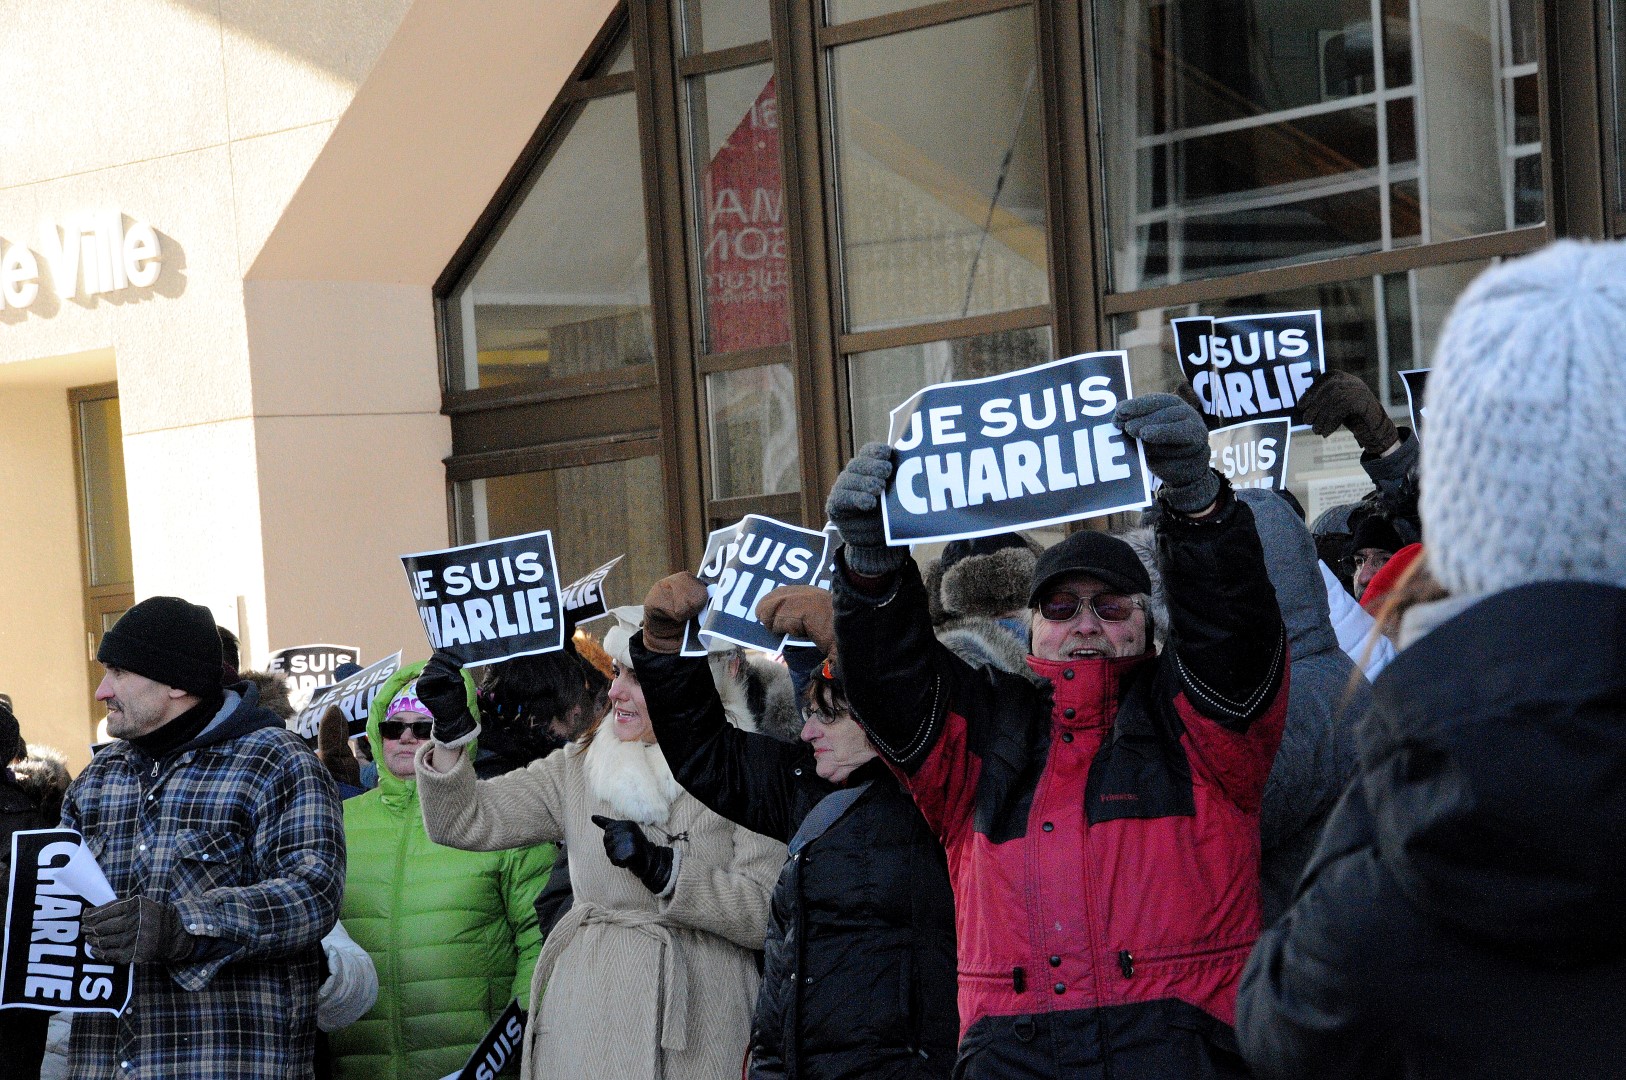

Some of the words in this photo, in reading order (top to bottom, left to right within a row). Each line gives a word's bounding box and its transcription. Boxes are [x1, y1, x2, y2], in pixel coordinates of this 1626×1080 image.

[0, 241, 39, 311] e
[42, 207, 161, 299] Ville
[894, 405, 966, 451] JE
[980, 376, 1117, 437] SUIS
[896, 423, 1131, 515] CHARLIE
[1222, 437, 1277, 478] SUIS
[413, 570, 437, 600] JE
[443, 552, 544, 596] SUIS
[270, 657, 285, 674] E
[290, 653, 351, 673] SUIS
[308, 687, 342, 709] JE
[341, 663, 396, 696] SUIS
[475, 1015, 522, 1080] SUIS
